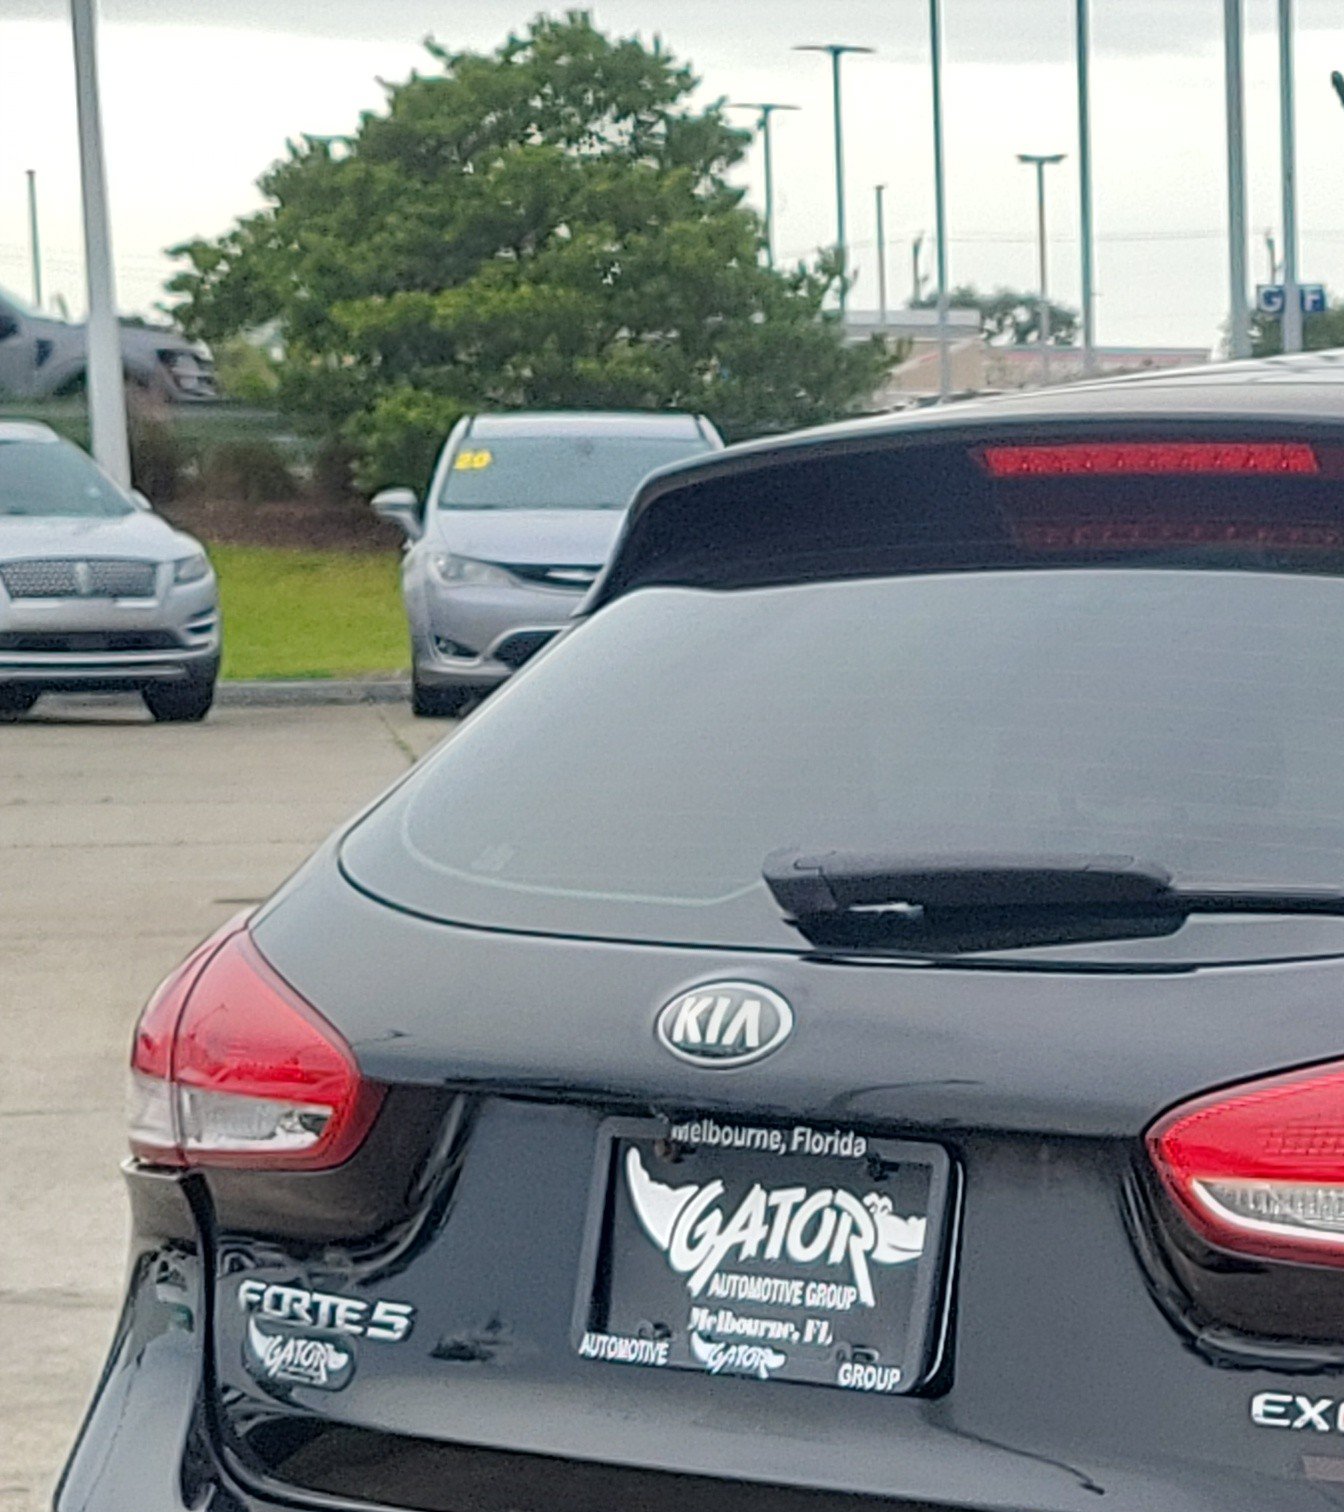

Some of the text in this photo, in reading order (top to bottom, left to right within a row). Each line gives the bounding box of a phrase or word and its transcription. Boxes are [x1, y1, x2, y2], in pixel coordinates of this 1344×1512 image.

[672, 996, 761, 1048] KIA
[670, 1118, 867, 1158] Melbourne, Florida
[670, 1178, 876, 1307] GATOR
[707, 1271, 858, 1311] AUTOMOTIVE GROUP
[686, 1306, 834, 1347] Melbourne, FL
[263, 1335, 333, 1387] GATOR
[578, 1331, 669, 1367] AUTOMOTIVE
[706, 1341, 772, 1380] GATOR
[837, 1362, 902, 1393] GROUP
[1252, 1392, 1334, 1432] EX
